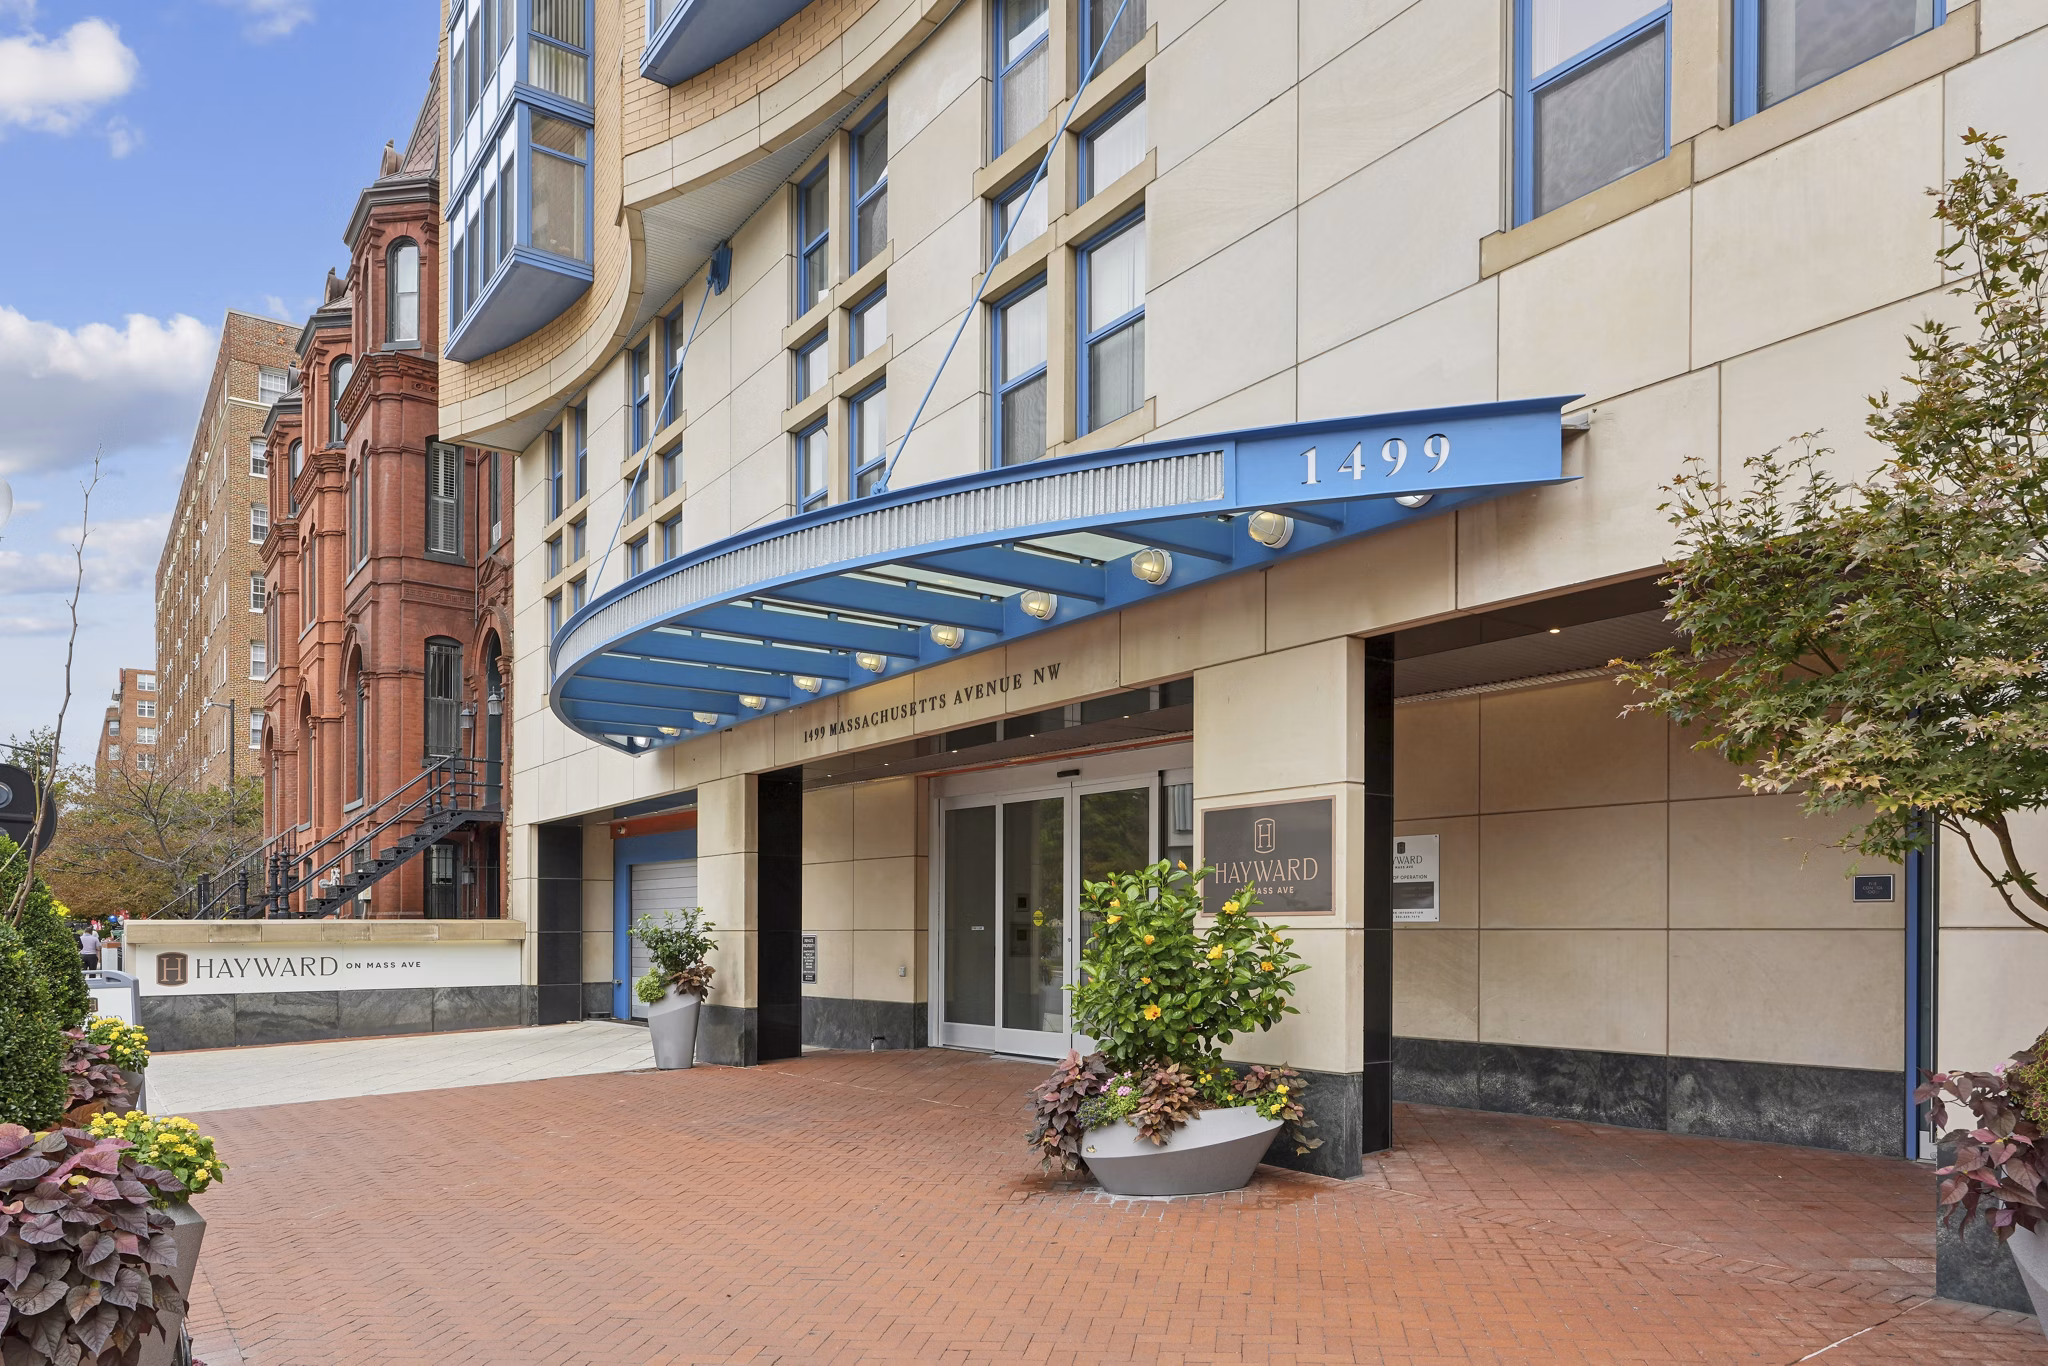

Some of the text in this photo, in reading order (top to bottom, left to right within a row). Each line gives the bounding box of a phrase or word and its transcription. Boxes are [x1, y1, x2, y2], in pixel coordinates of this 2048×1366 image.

[1300, 433, 1450, 485] 1499
[803, 662, 1062, 743] 1499 MASSACHUSETTS AVENUE NW
[1215, 857, 1318, 884] HAYWARD
[1393, 855, 1423, 865] YWARD
[1277, 886, 1294, 894] AVE
[160, 956, 421, 982] H HAYWARD ON MASS AVE
